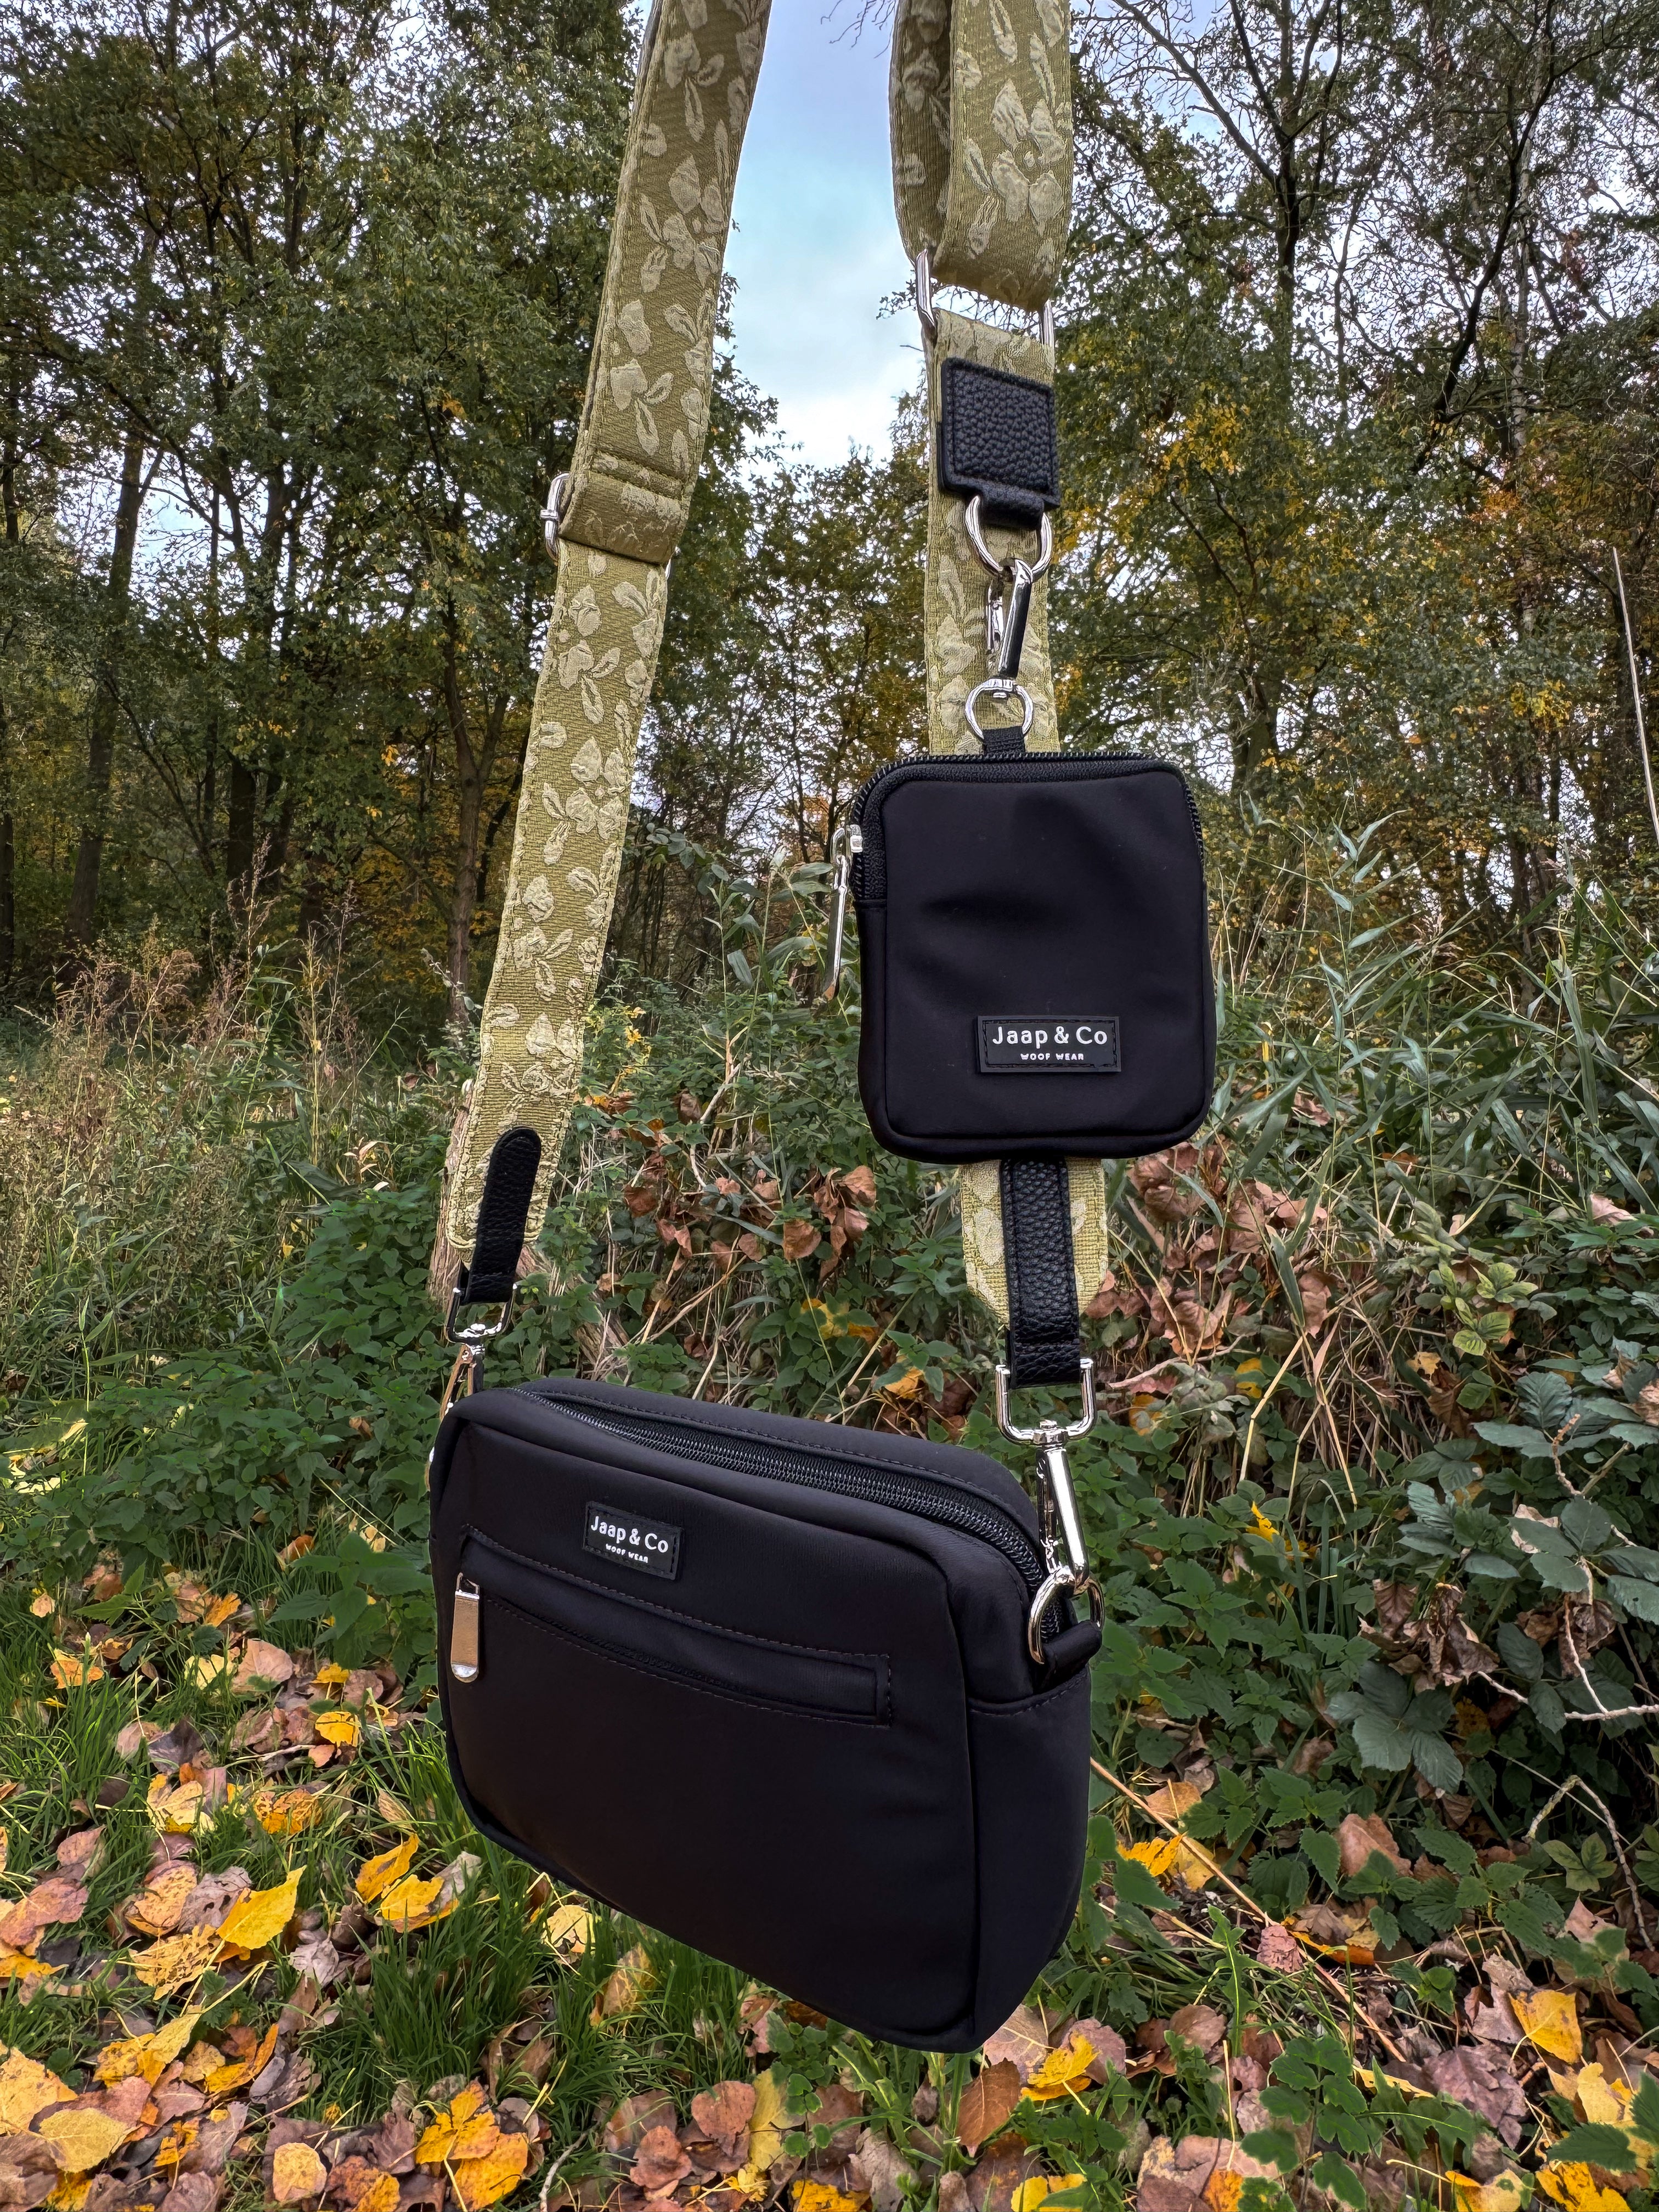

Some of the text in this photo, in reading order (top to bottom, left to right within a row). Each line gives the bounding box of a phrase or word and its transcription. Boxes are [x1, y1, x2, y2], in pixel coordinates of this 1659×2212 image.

[992, 1026, 1108, 1049] Jaap & Co
[590, 1516, 669, 1553] Jaap & Co
[605, 1543, 648, 1564] WOOF WEAR
